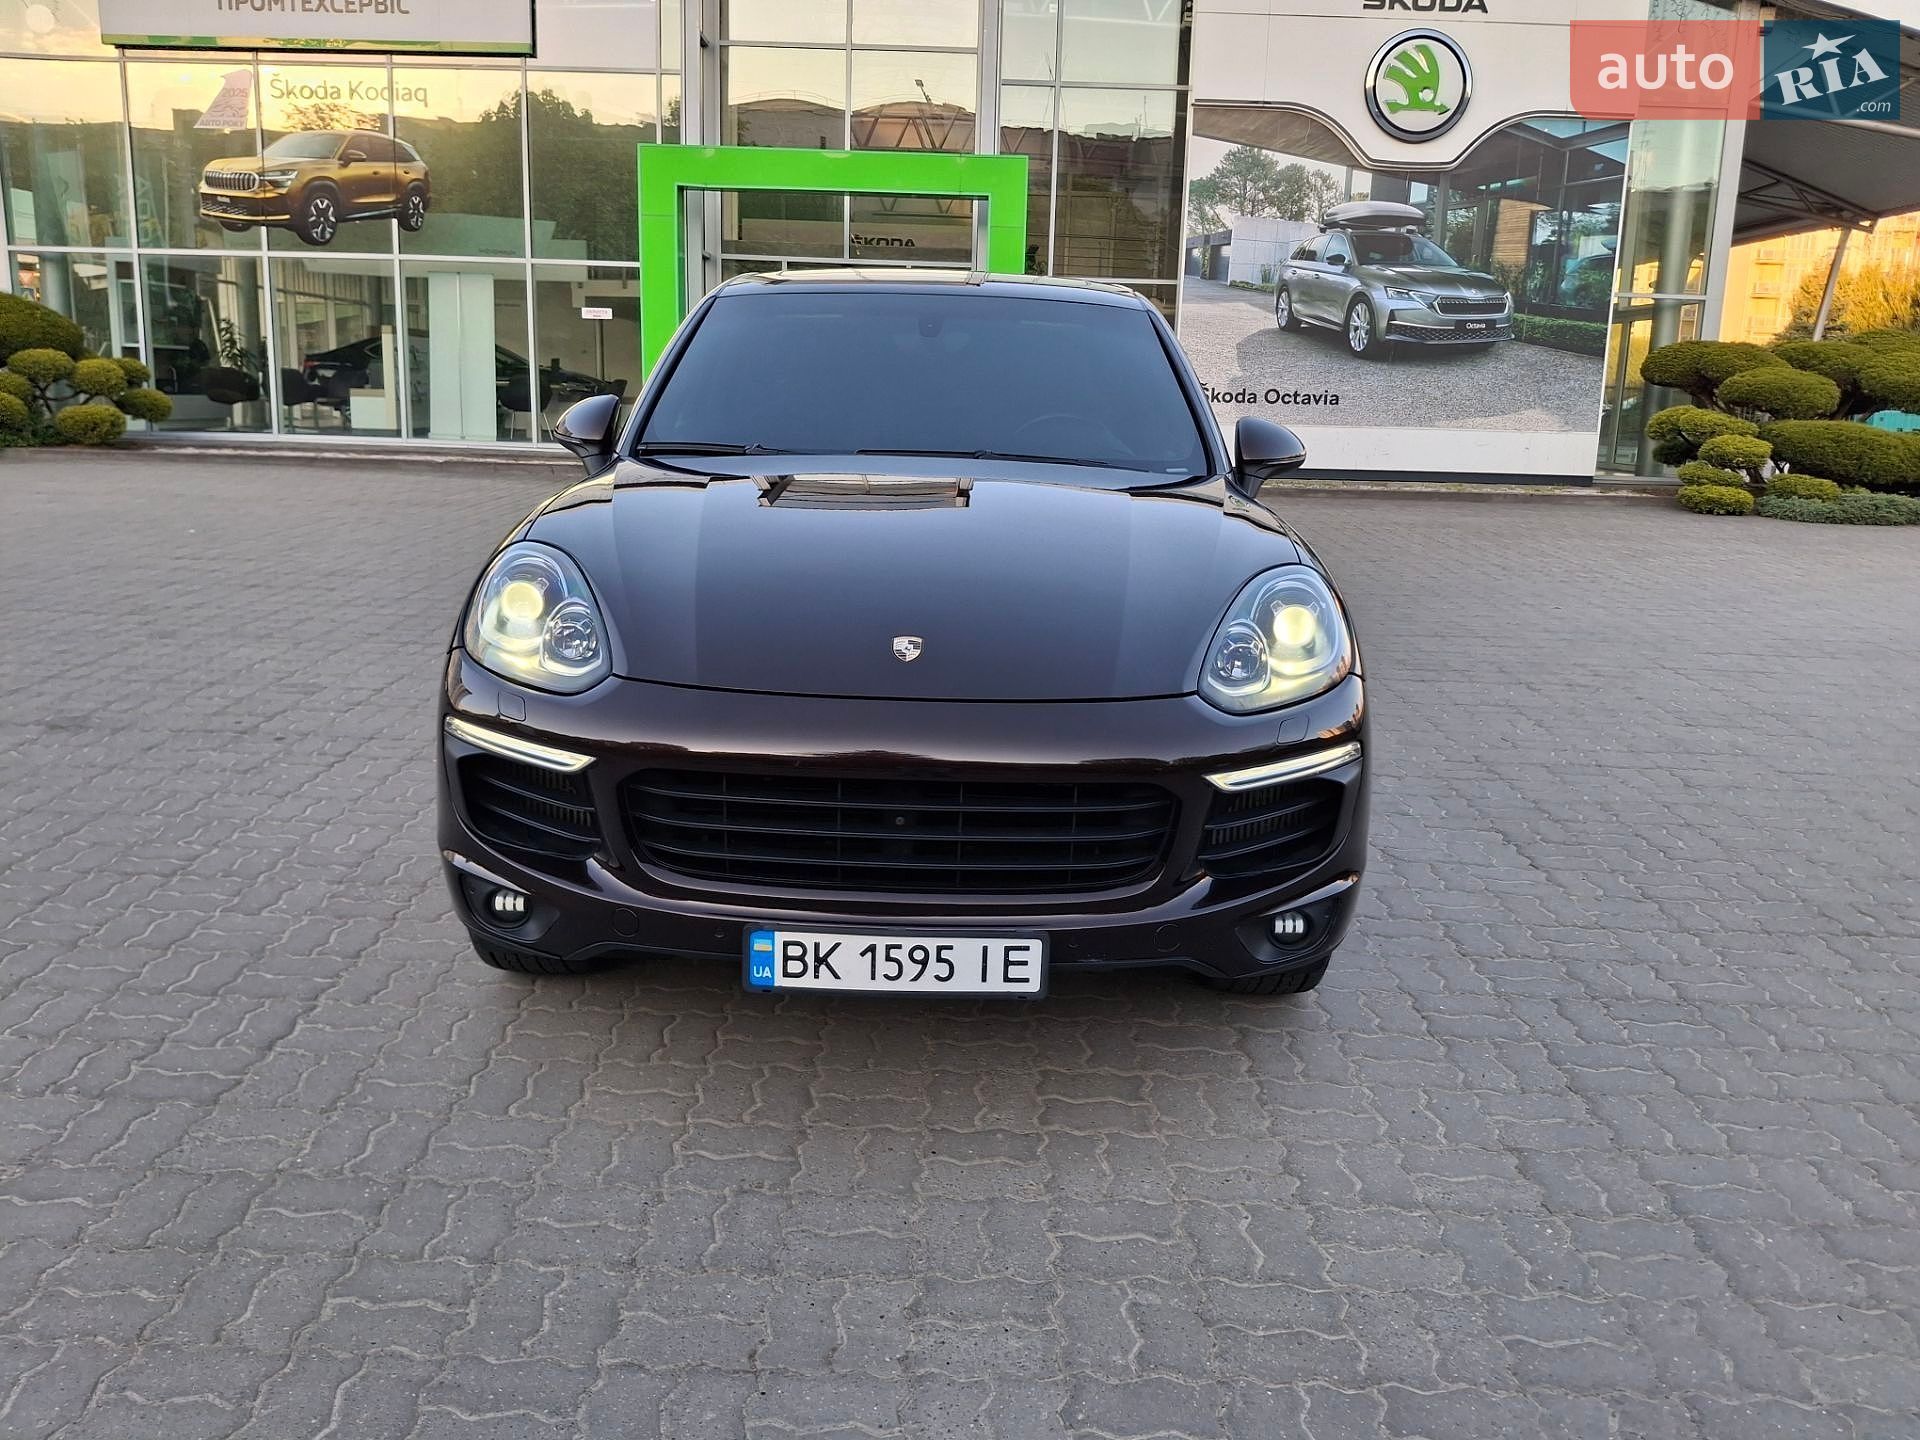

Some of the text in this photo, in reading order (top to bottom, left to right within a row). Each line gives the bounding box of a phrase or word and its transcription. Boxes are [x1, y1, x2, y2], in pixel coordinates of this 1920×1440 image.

[269, 74, 429, 108] Škoda Kodiaq
[1264, 388, 1340, 406] Octavia
[753, 965, 773, 979] UA
[781, 940, 1031, 984] BK 1595 IE
